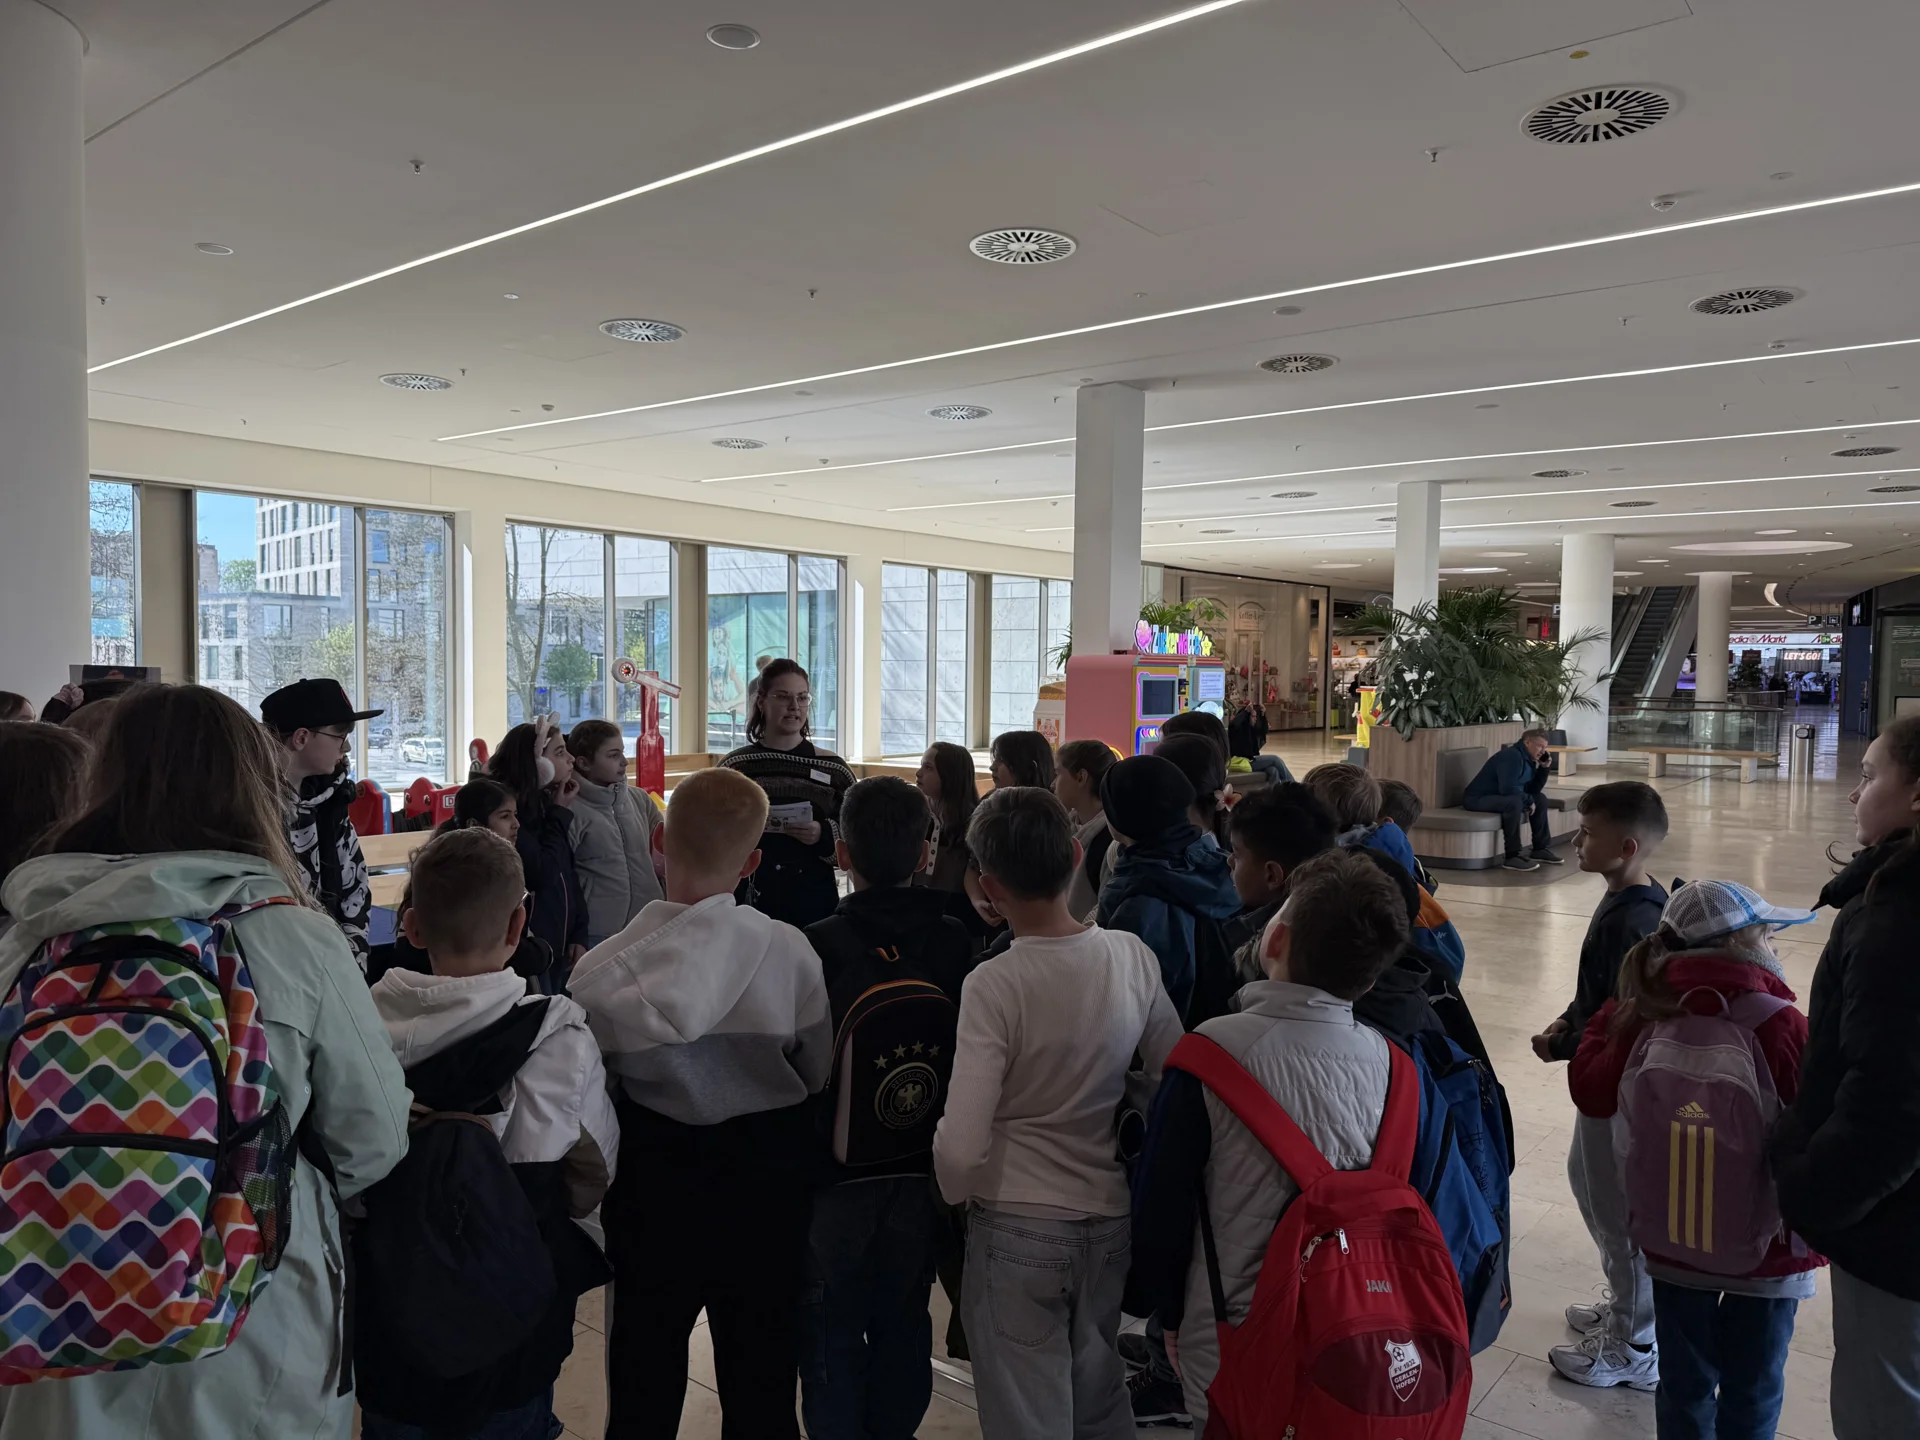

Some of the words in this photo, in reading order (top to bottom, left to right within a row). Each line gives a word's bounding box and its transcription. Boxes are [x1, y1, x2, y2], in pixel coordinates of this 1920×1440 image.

[1808, 615, 1817, 625] P
[1729, 635, 1749, 643] edia
[1757, 634, 1787, 643] Markt
[1784, 652, 1804, 660] LET'S
[1805, 652, 1822, 660] GO!
[1676, 1109, 1711, 1119] adidas
[1365, 1279, 1393, 1293] JAKO
[1394, 1365, 1402, 1374] FV
[1395, 1376, 1416, 1390] HOFEN
